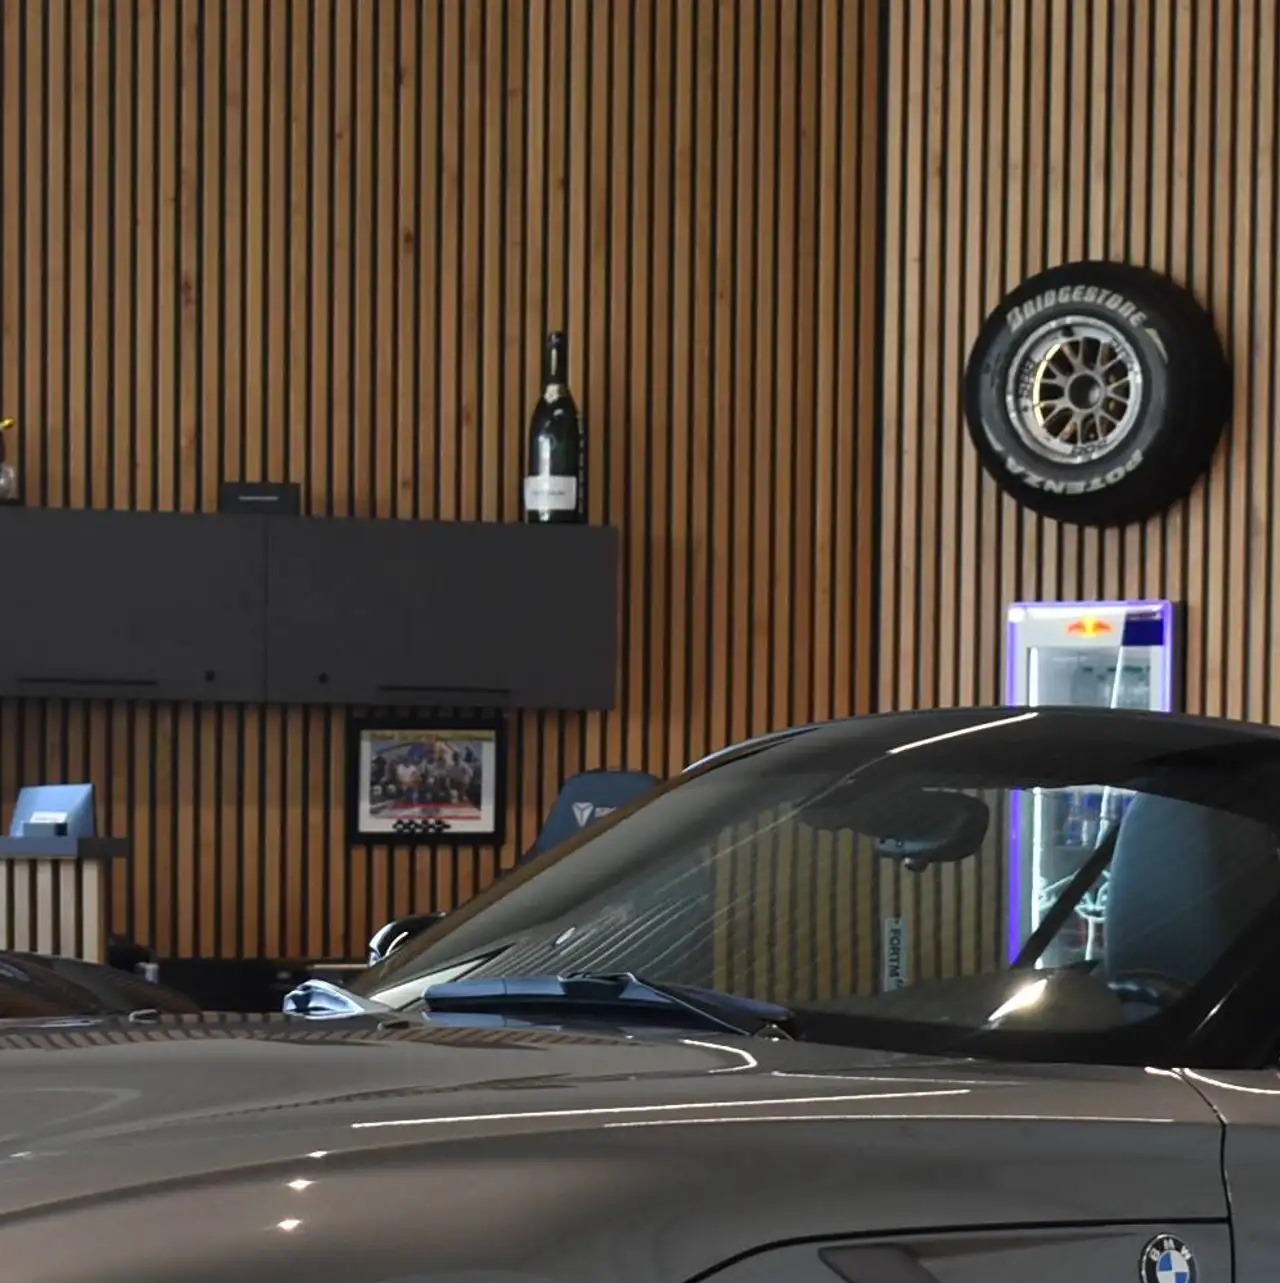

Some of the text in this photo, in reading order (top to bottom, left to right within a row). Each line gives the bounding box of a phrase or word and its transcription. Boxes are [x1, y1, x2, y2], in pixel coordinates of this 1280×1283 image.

[1006, 284, 1148, 333] BRIDGESTONE
[1005, 448, 1144, 494] POTENZA
[1148, 1238, 1193, 1264] BMW
